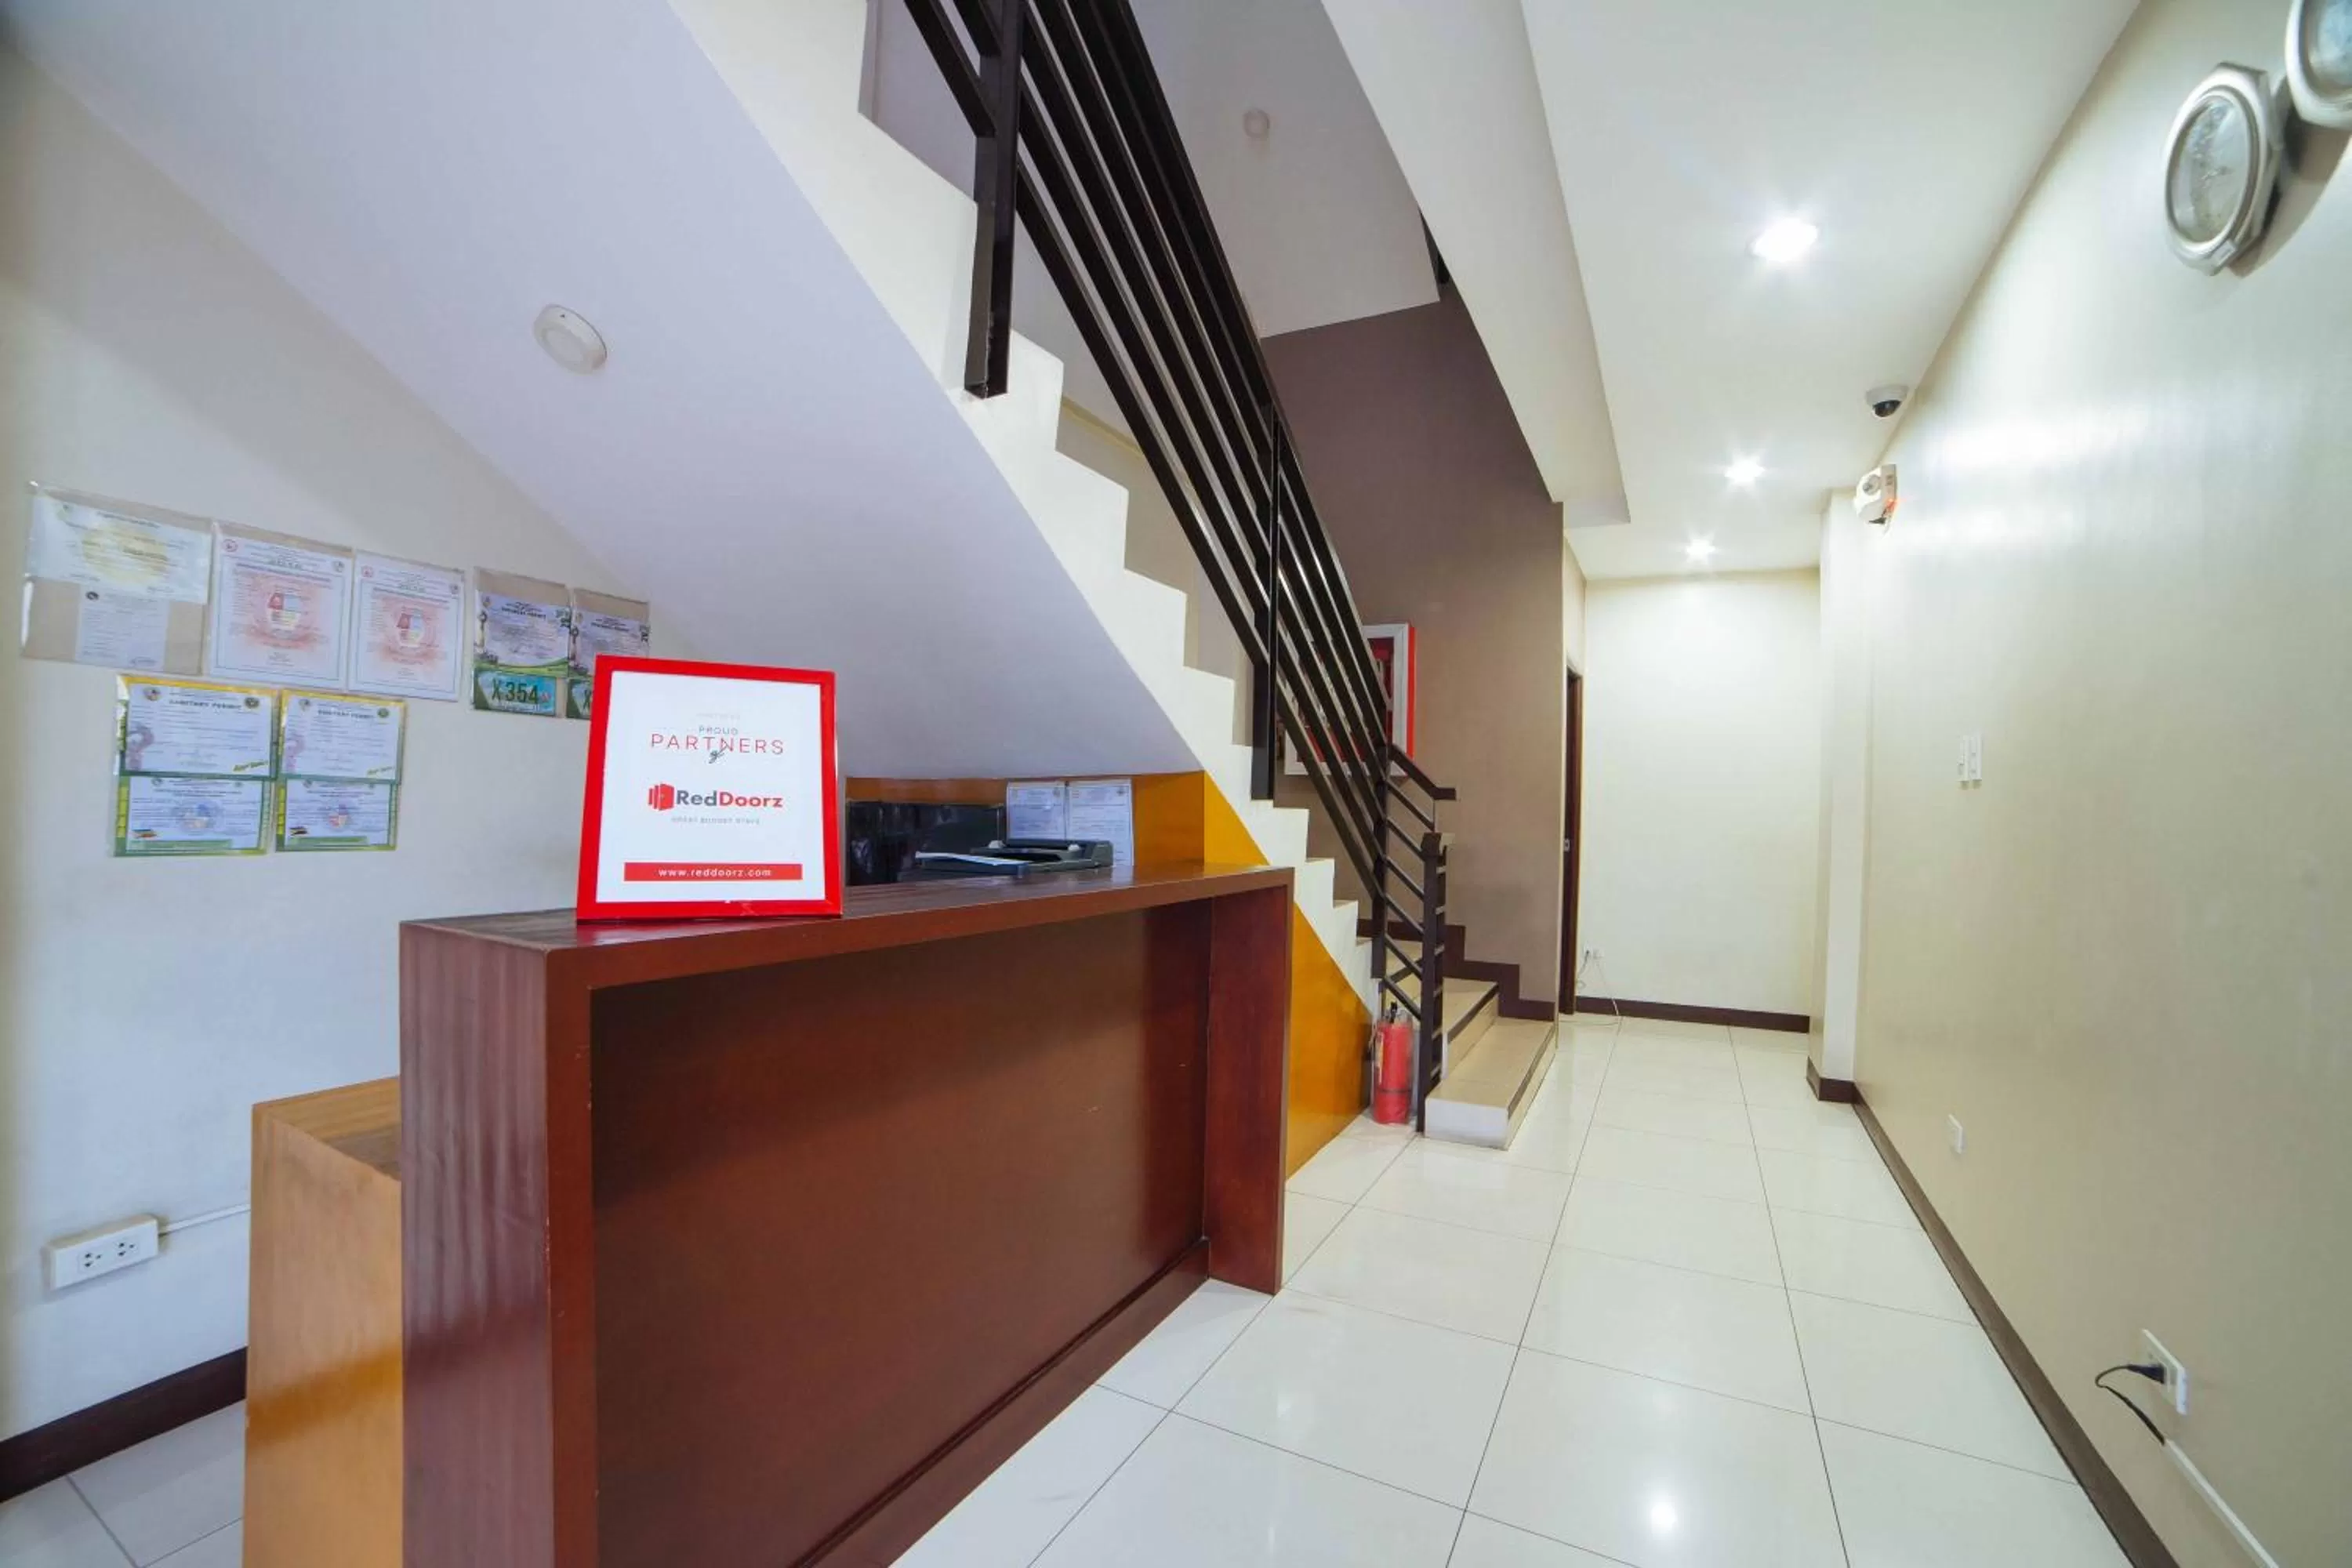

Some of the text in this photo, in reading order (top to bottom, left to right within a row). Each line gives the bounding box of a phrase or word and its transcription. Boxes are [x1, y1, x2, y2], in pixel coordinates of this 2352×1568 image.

[699, 725, 739, 735] PROUD
[651, 733, 784, 755] PARTNERS
[677, 789, 783, 808] RedDoorz
[658, 868, 771, 877] www.reddoorz.com
